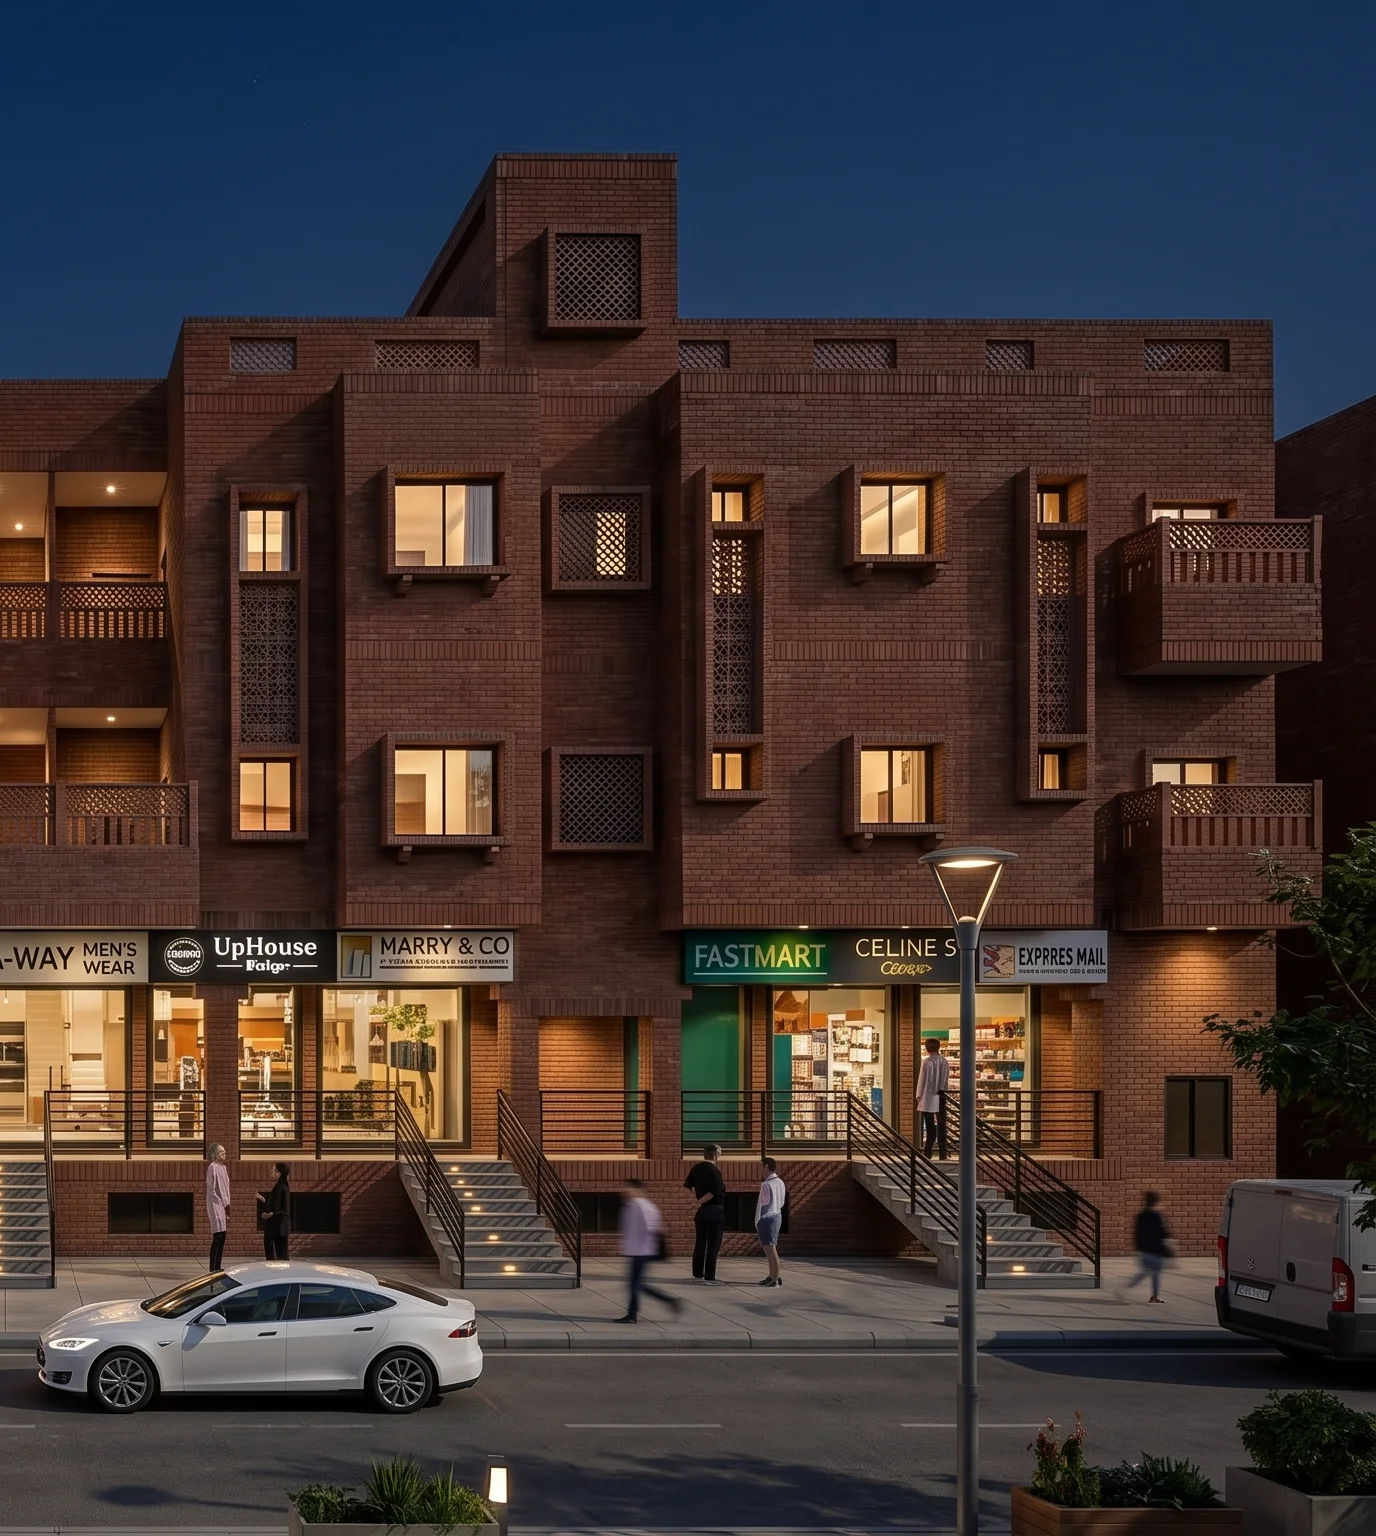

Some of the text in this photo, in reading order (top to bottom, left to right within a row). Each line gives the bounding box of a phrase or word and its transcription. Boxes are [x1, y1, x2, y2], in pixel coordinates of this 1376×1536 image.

[83, 942, 137, 957] MEN'S
[214, 937, 317, 960] UpHouse
[380, 936, 510, 955] MARRY & CO
[855, 938, 957, 957] CELINE S
[695, 944, 826, 968] FASTMART
[1018, 947, 1106, 966] EXPRRES MAIL
[83, 960, 135, 975] WEAR
